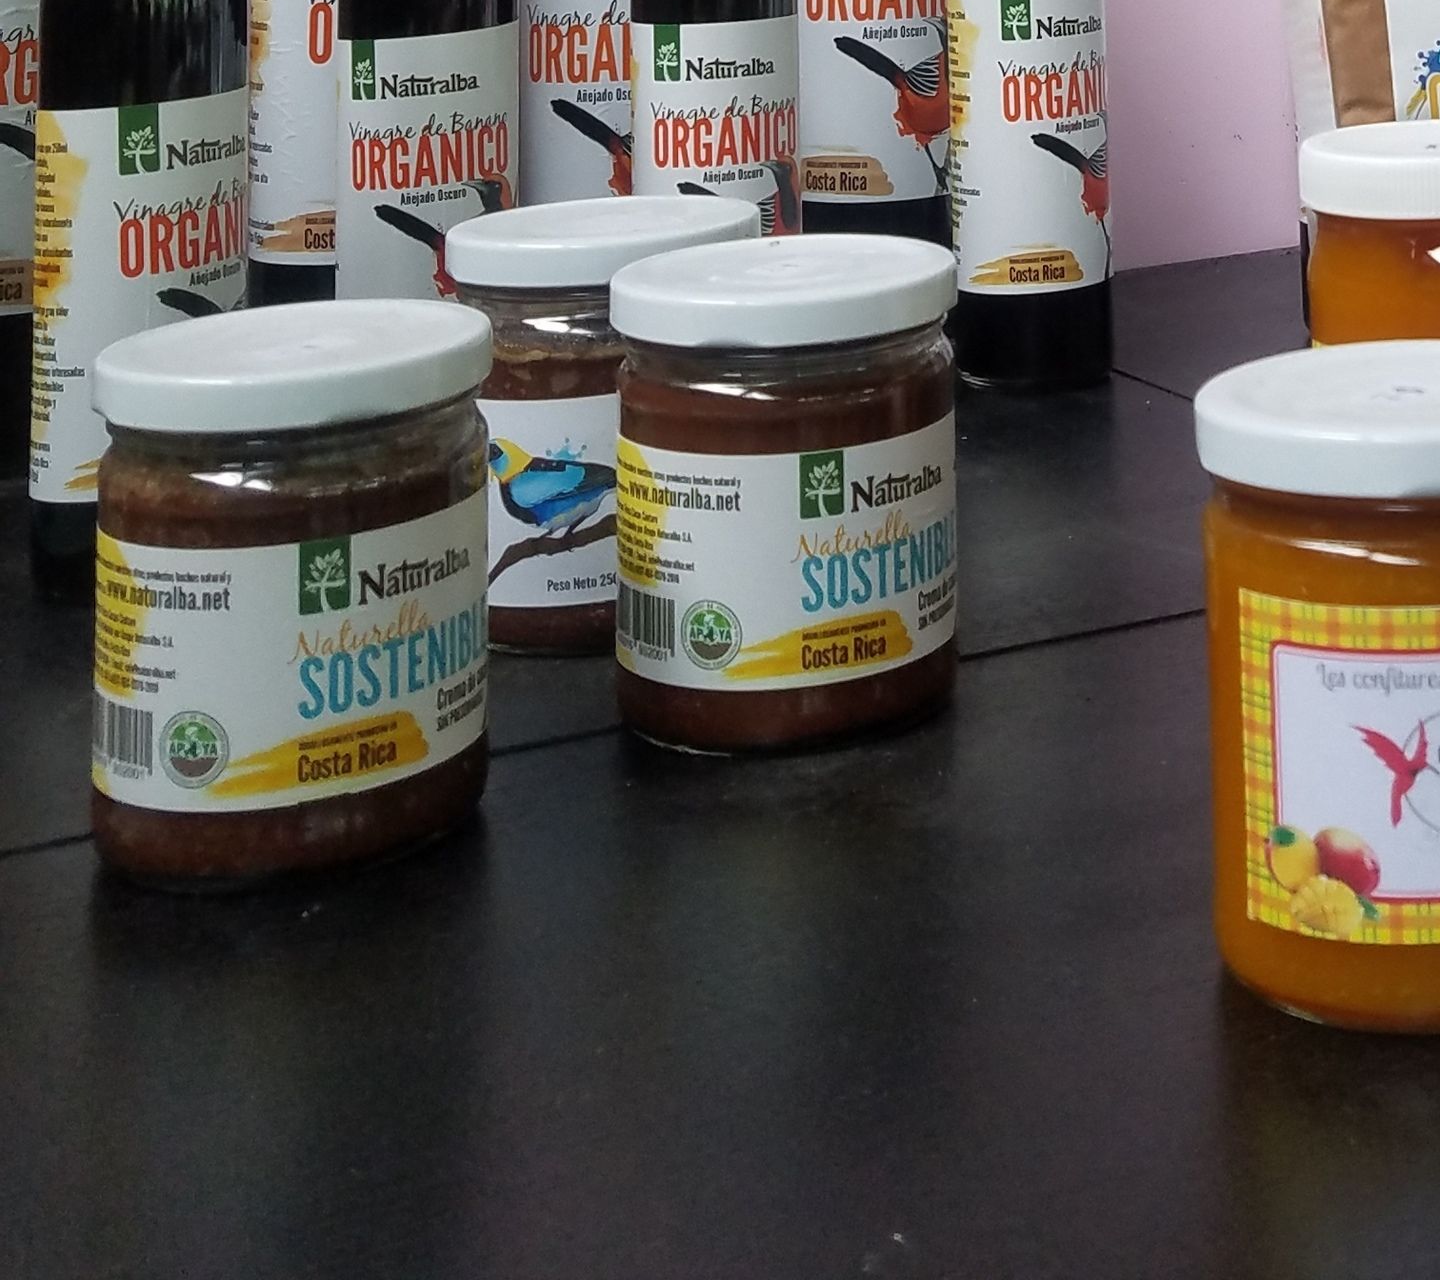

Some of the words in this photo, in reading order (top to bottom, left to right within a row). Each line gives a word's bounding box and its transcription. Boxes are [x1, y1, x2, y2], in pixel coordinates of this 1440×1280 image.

[527, 3, 596, 37] Vinagre
[602, 0, 630, 26] de
[1036, 15, 1102, 40] Naturalba
[684, 57, 775, 81] Naturalba
[998, 59, 1068, 85] Vinagre
[379, 72, 480, 100] Naturalba
[615, 88, 633, 103] Osc
[650, 101, 721, 127] Vinagre
[724, 96, 749, 121] de
[349, 120, 417, 146] Vinagre
[421, 112, 446, 138] de
[805, 169, 836, 192] Costa
[840, 171, 868, 192] Rica
[113, 196, 208, 237] Vinagre
[304, 227, 335, 251] Cost
[1009, 266, 1040, 283] Costa
[1043, 264, 1065, 281] Rica
[0, 279, 22, 303] ica
[629, 480, 741, 512] www.naturalba.net
[850, 464, 942, 513] Naturalba
[790, 508, 915, 564] Naturella
[357, 547, 471, 606] Naturalba
[547, 576, 571, 593] Peso
[573, 575, 598, 591] Neto
[286, 598, 433, 665] Naturella
[801, 642, 849, 671] Costa
[853, 635, 887, 663] Rica
[297, 749, 353, 784] Costa
[358, 739, 398, 771] Rica
